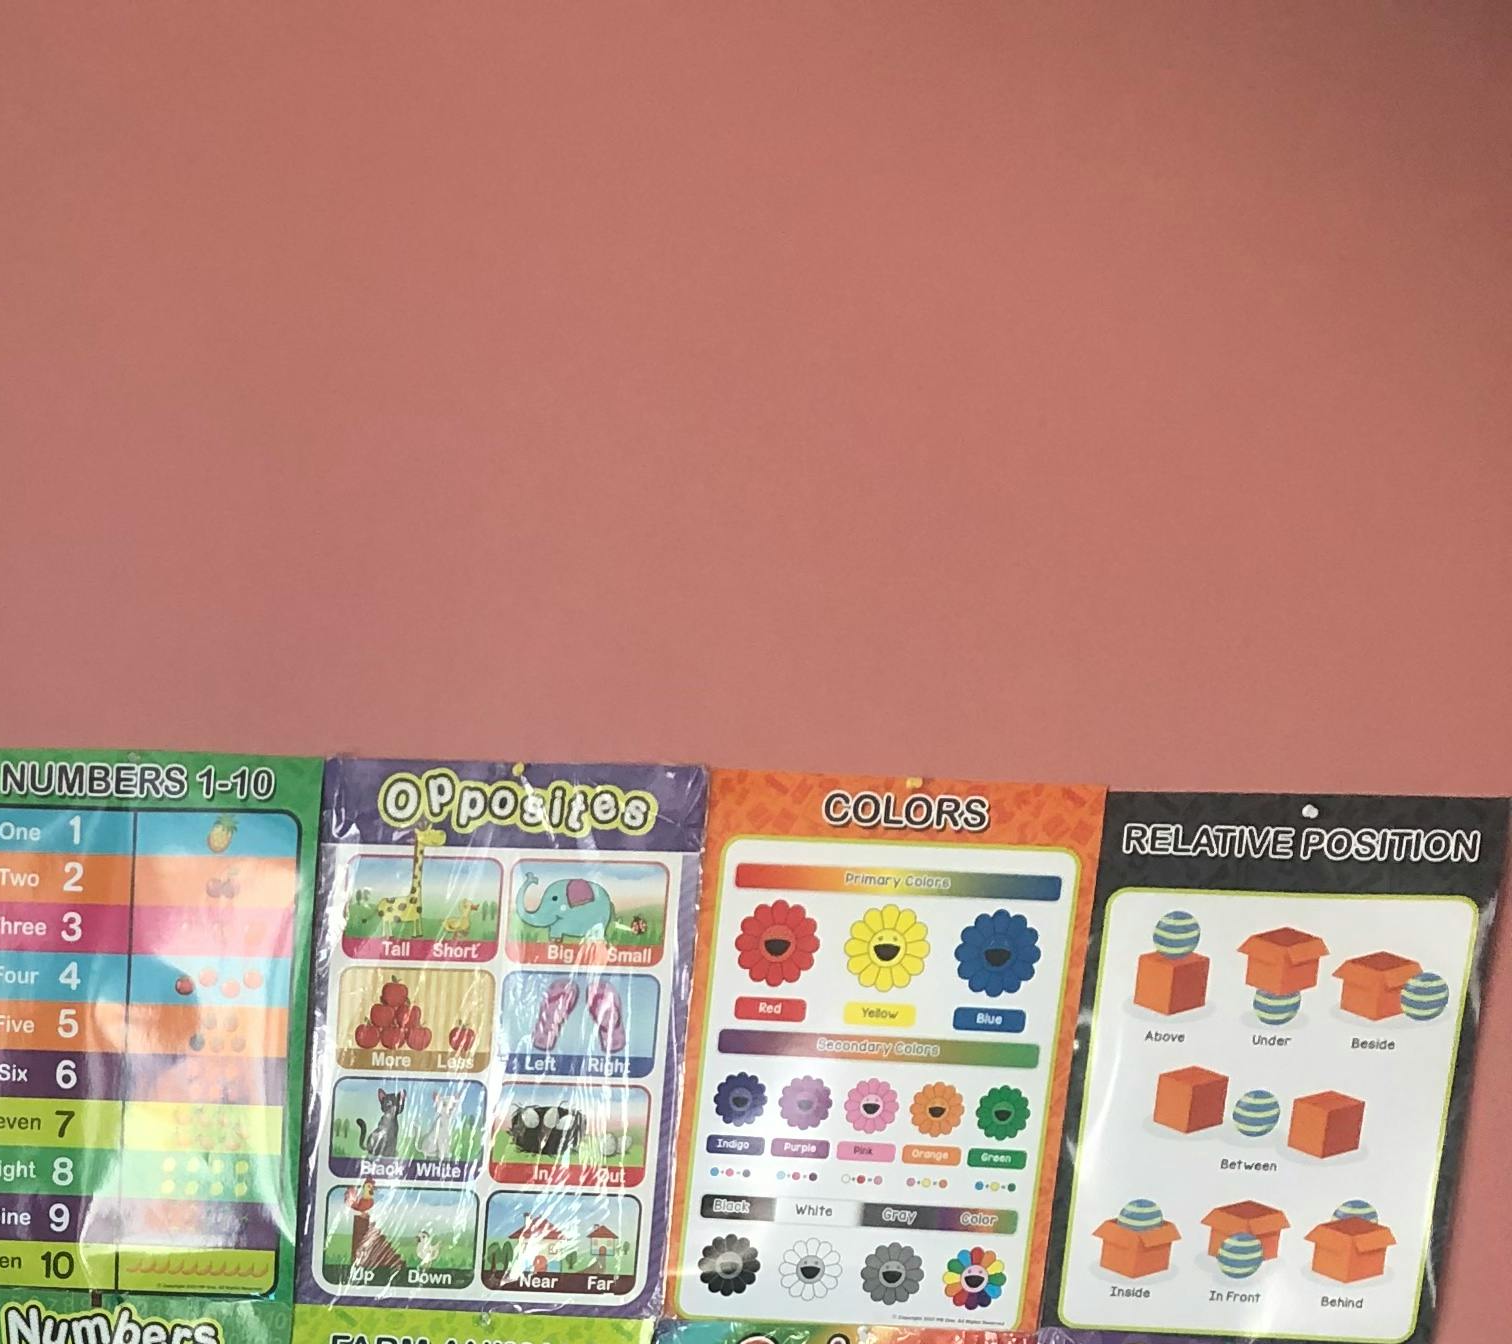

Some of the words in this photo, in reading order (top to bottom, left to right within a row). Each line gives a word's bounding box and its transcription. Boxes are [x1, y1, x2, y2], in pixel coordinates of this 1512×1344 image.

[1, 760, 188, 798] NUMBERS
[195, 767, 275, 800] 1-10
[380, 770, 654, 835] Opposites
[823, 793, 991, 832] COLORS
[69, 816, 81, 844] 1
[1122, 824, 1295, 858] RELATIVE
[1300, 827, 1481, 864] POSITION
[63, 862, 83, 892] 2
[844, 871, 900, 890] Primary
[905, 875, 951, 890] Colors
[60, 912, 82, 941] 3
[383, 941, 410, 957] Tall
[433, 943, 479, 959] Short
[58, 961, 81, 990] 4
[759, 1002, 781, 1015] Red
[861, 1007, 898, 1021] Yellow
[57, 1009, 79, 1038] 5
[977, 1012, 1002, 1026] Blue
[1145, 1031, 1185, 1044] Above
[1252, 1035, 1291, 1047] Under
[1351, 1038, 1395, 1051] Beside
[372, 1053, 411, 1068] More
[55, 1059, 77, 1089] 6
[54, 1111, 75, 1137] 7
[51, 1156, 74, 1185] 8
[415, 1163, 461, 1179] White
[1220, 1158, 1277, 1173] Between
[48, 1203, 70, 1232] 9
[795, 1204, 832, 1219] White
[960, 1212, 997, 1227] Color
[40, 1250, 74, 1279] 10
[408, 1270, 452, 1285] Down
[519, 1274, 558, 1289] Near
[587, 1276, 614, 1290] Far
[1110, 1286, 1150, 1299] Inside
[1209, 1290, 1221, 1302] In
[1225, 1292, 1260, 1303] Front
[1320, 1296, 1363, 1309] Behind
